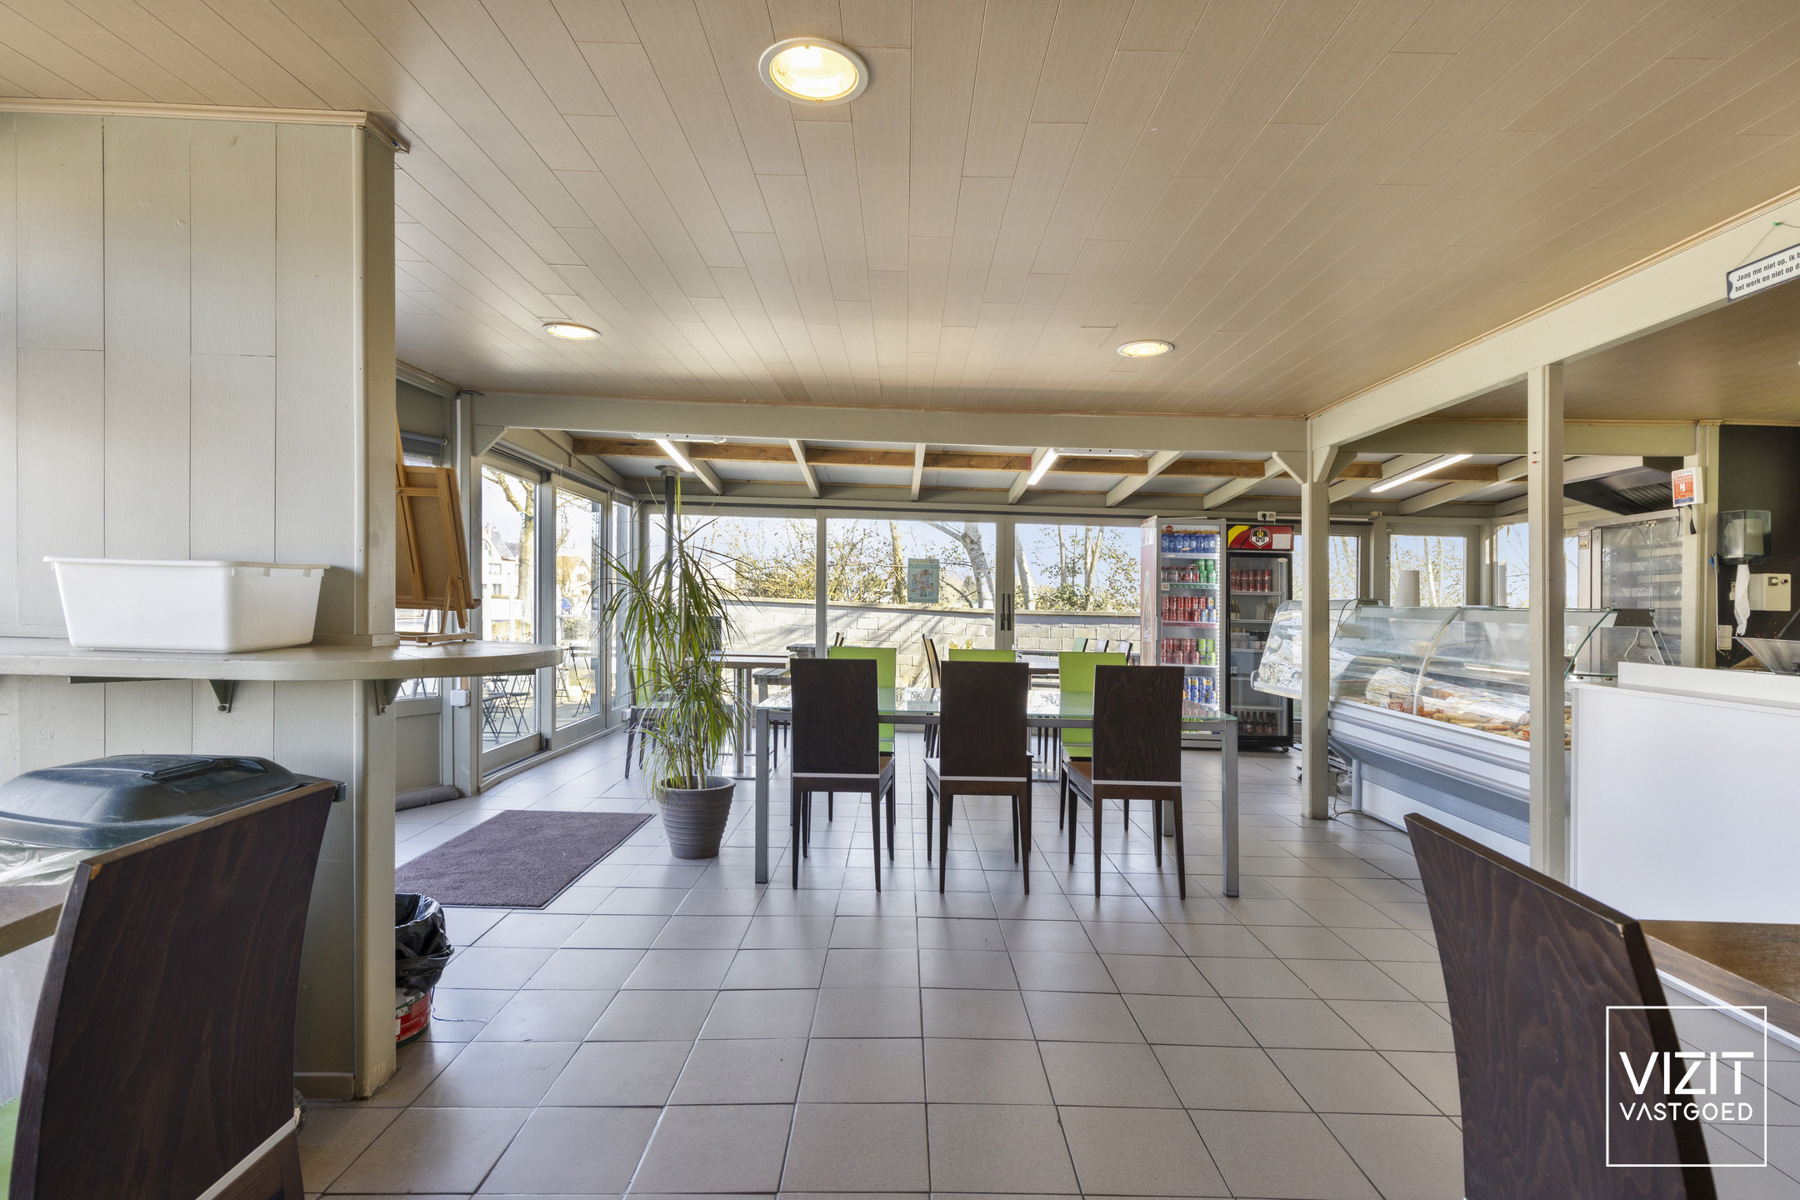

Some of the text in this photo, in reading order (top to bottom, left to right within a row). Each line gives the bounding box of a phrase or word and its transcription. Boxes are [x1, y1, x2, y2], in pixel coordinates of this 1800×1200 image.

[1735, 284, 1744, 292] het
[1746, 278, 1761, 288] werk
[1772, 269, 1783, 278] niet
[1737, 272, 1751, 282] Jaag
[1764, 262, 1775, 271] niet
